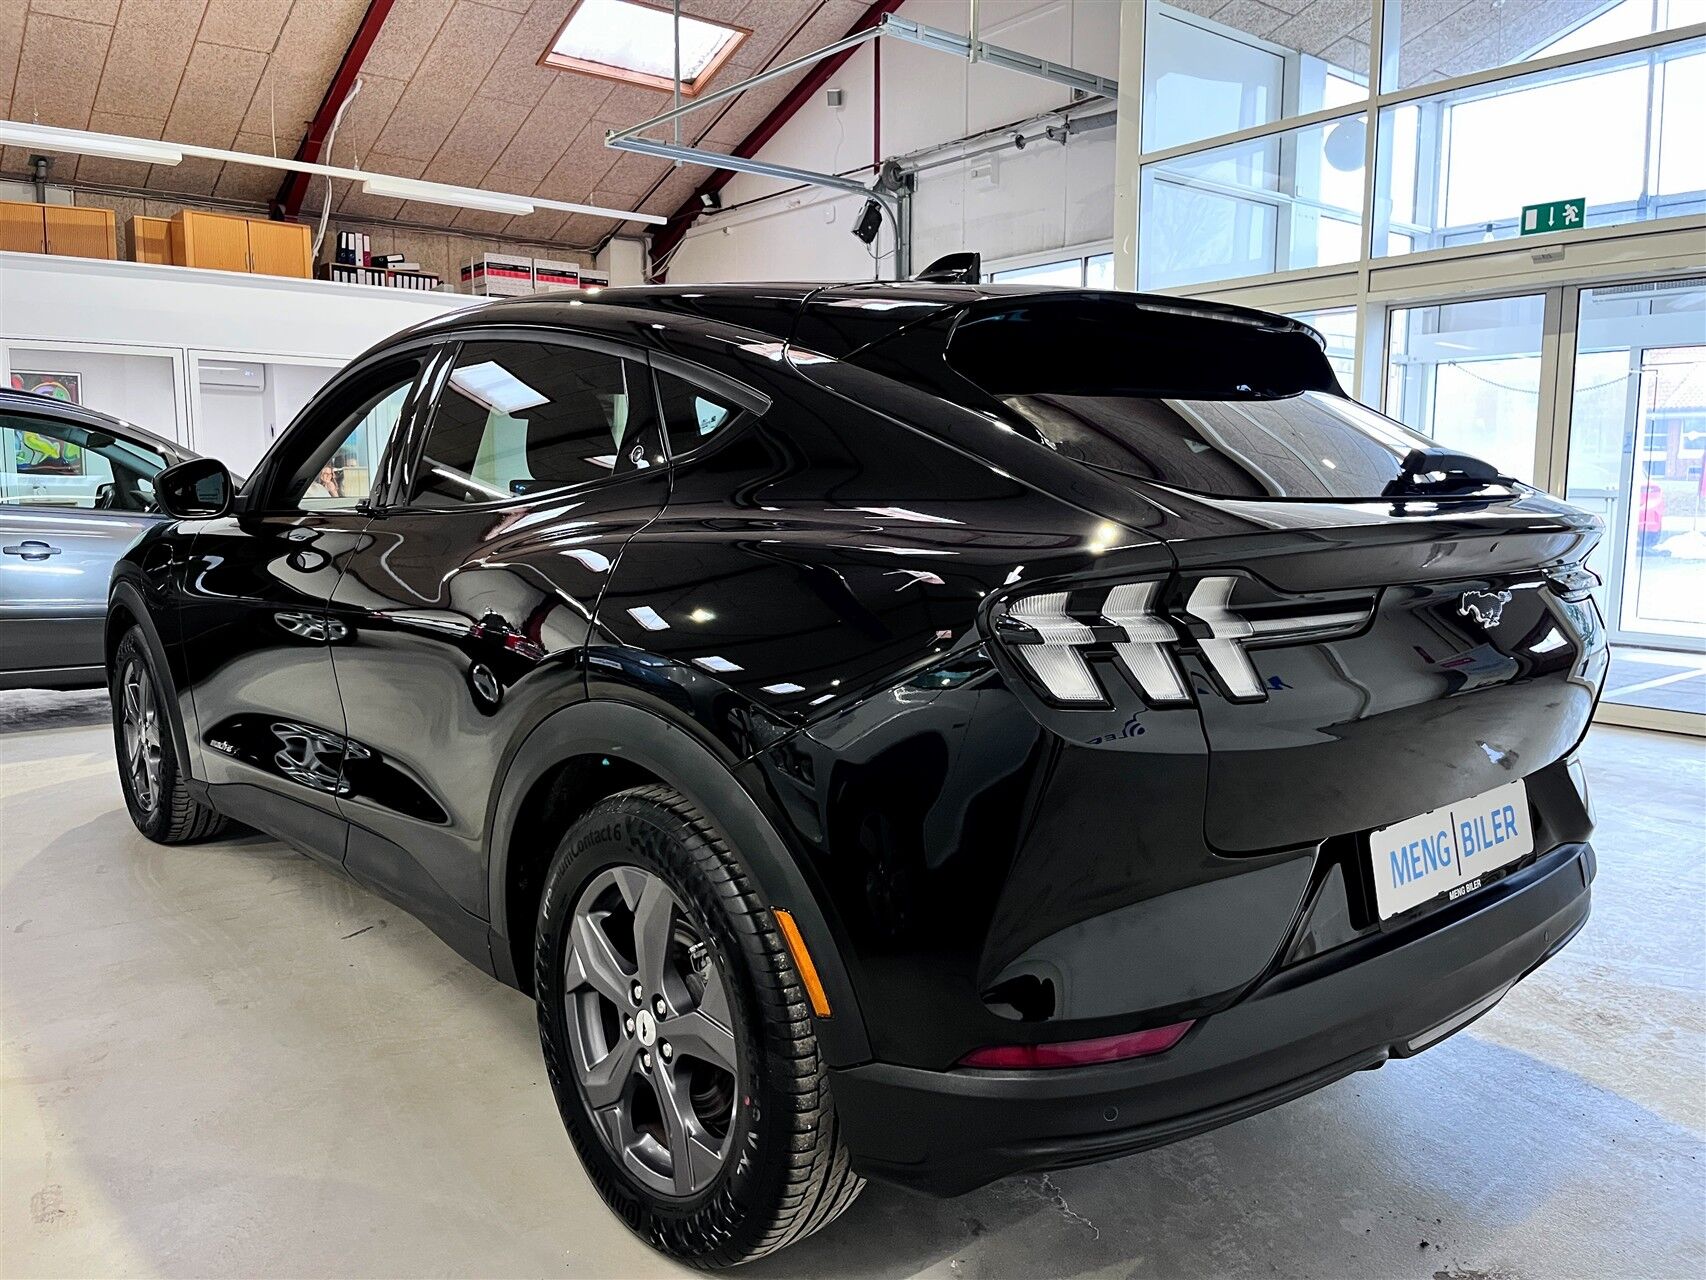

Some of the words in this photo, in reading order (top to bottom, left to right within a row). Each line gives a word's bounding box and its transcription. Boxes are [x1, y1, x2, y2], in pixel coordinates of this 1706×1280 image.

[613, 822, 622, 842] 6
[1389, 830, 1452, 889] MENG
[1459, 804, 1519, 858] BILER
[1449, 886, 1466, 900] MENG
[1465, 879, 1482, 893] BILER
